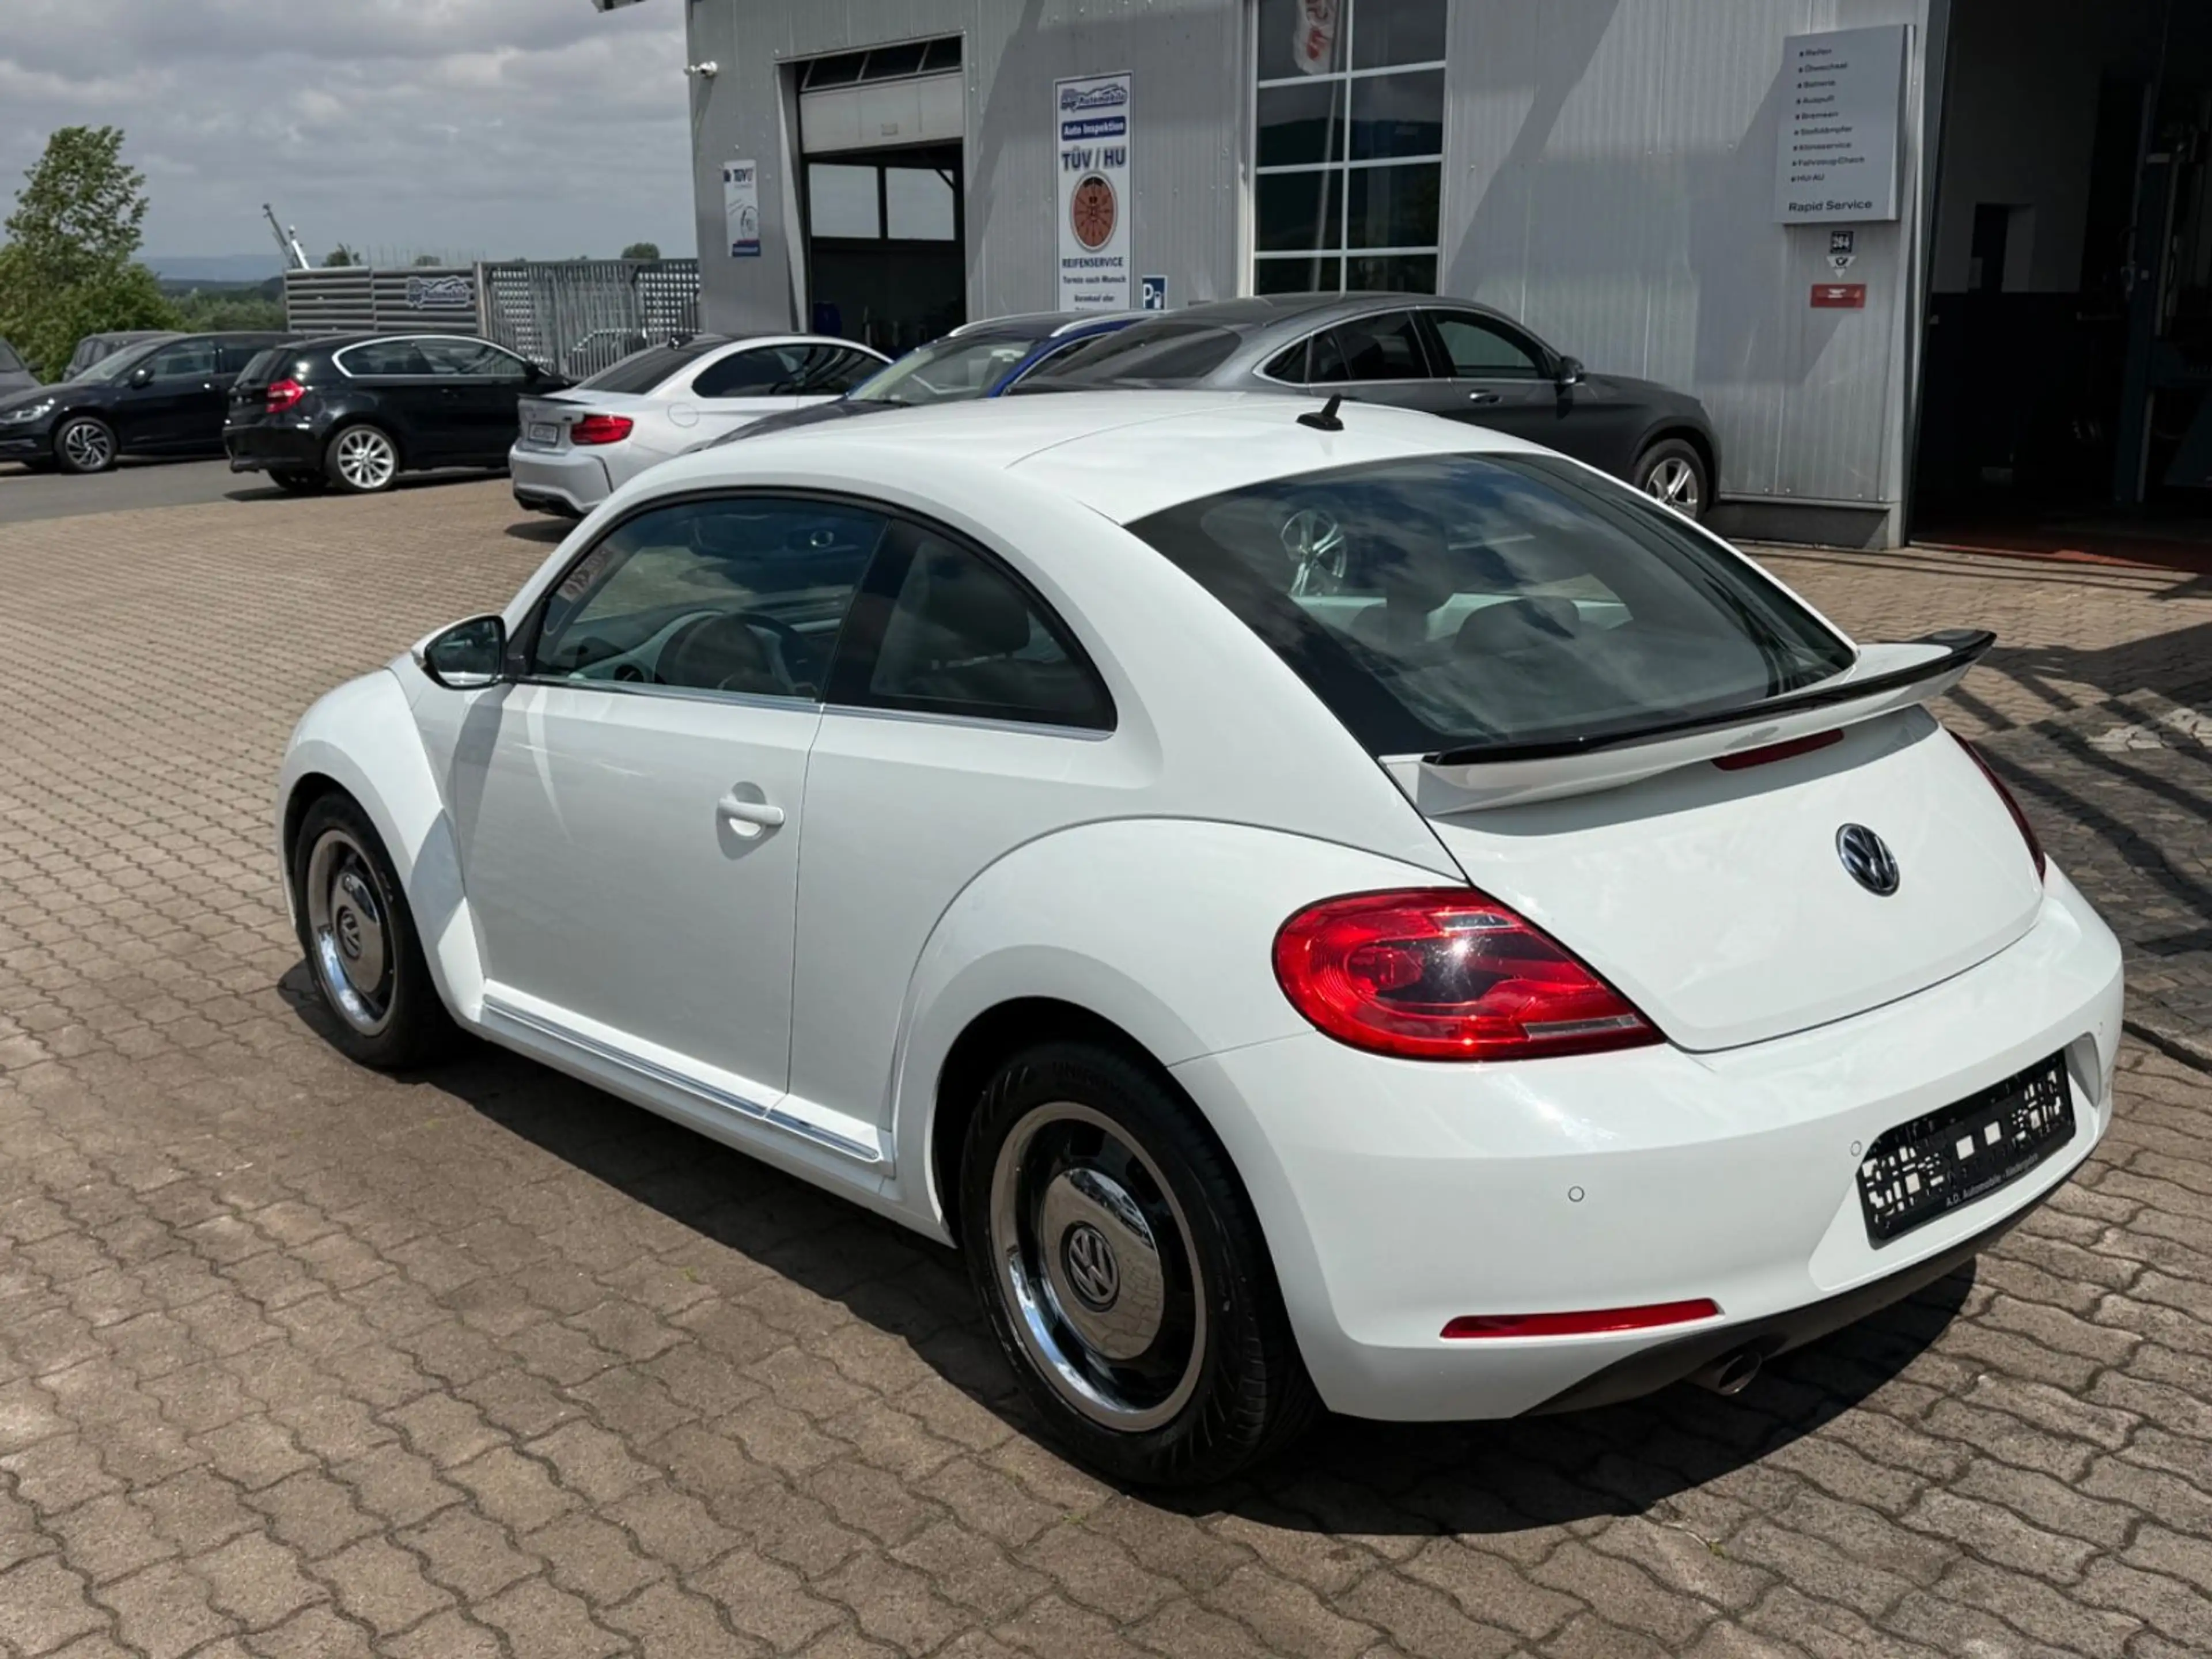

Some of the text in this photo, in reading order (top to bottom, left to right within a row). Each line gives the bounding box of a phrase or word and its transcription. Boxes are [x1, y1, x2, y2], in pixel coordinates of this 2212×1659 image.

[1063, 121, 1124, 136] Auto Inspektion
[1062, 146, 1093, 171] TÜV
[1104, 146, 1126, 168] HU
[1789, 200, 1872, 213] Rapid Service
[1062, 257, 1123, 268] REIFENSERVICE
[1143, 283, 1154, 308] P
